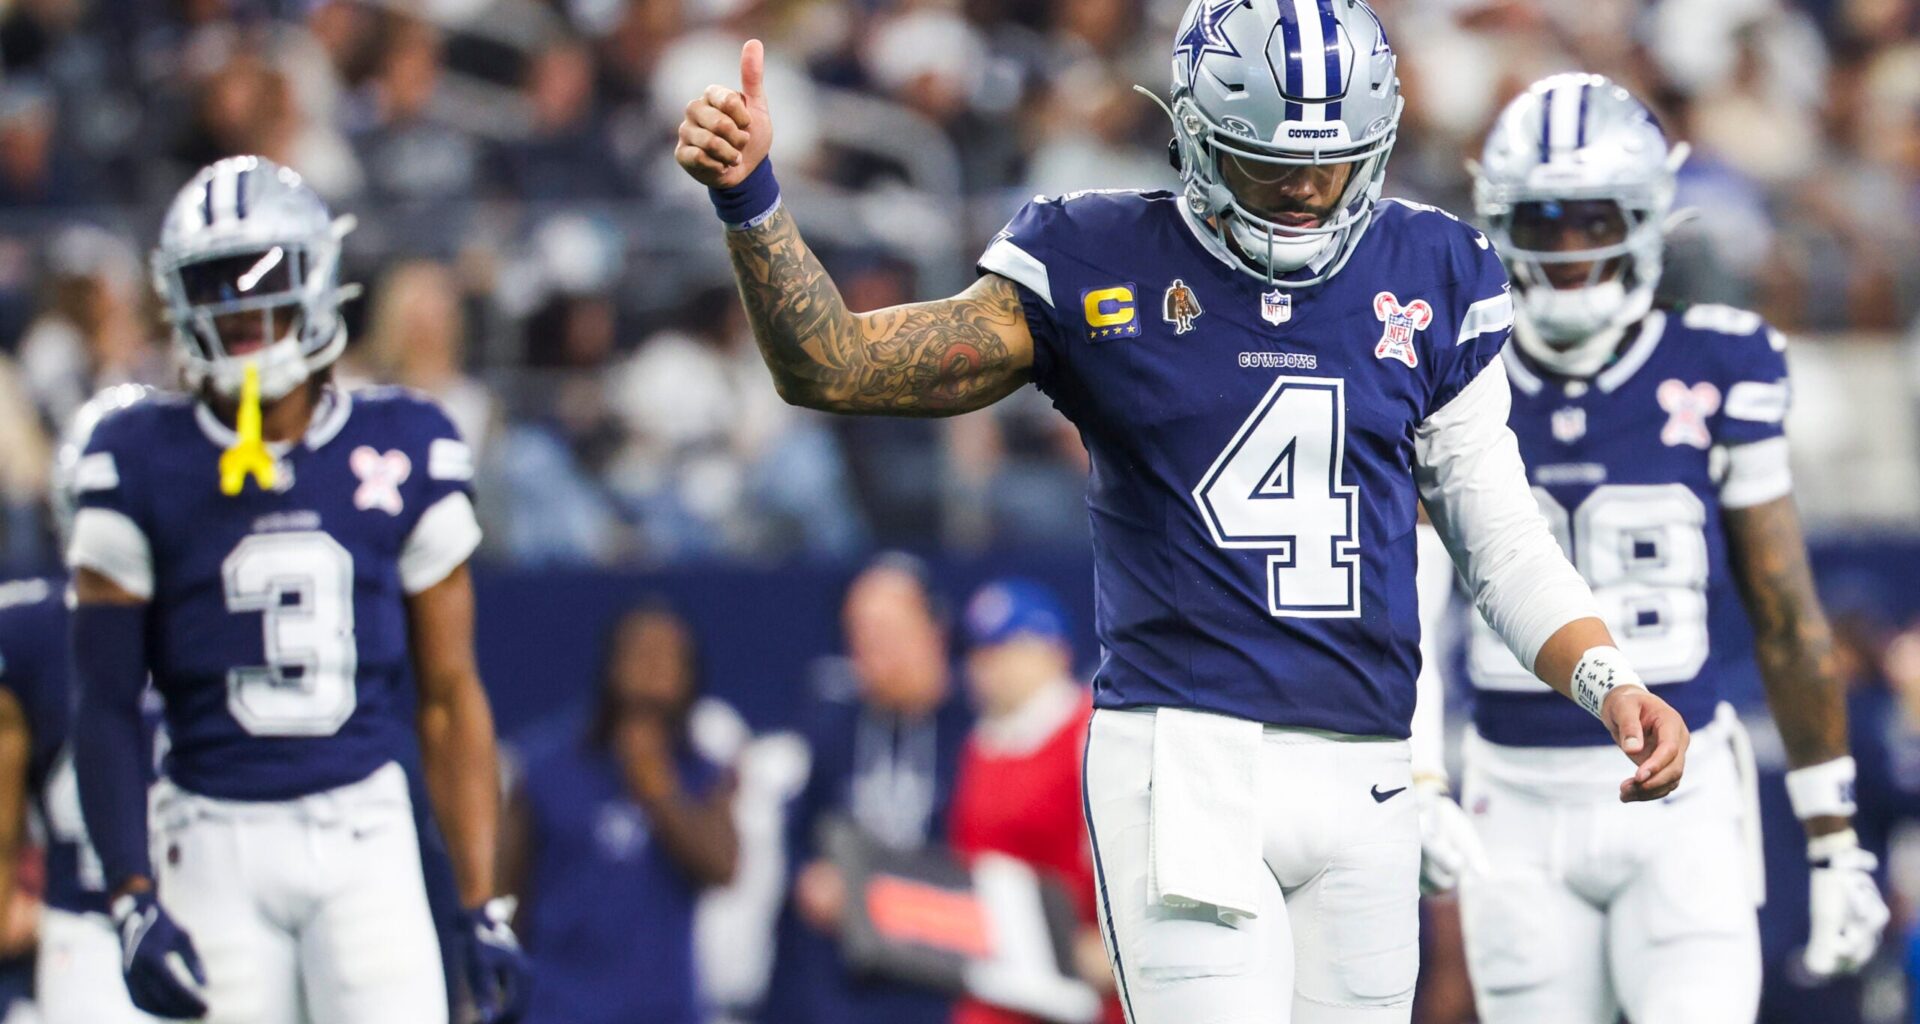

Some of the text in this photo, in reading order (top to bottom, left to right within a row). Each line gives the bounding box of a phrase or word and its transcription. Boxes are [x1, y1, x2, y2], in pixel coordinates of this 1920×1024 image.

[1288, 128, 1338, 139] COWBOYS
[1084, 286, 1135, 328] C
[1267, 304, 1286, 317] NFL
[1389, 325, 1409, 342] NFL
[1238, 352, 1317, 370] COWBOYS
[1191, 375, 1361, 618] 4
[221, 531, 357, 736] 3
[1578, 679, 1599, 710] FAITH
